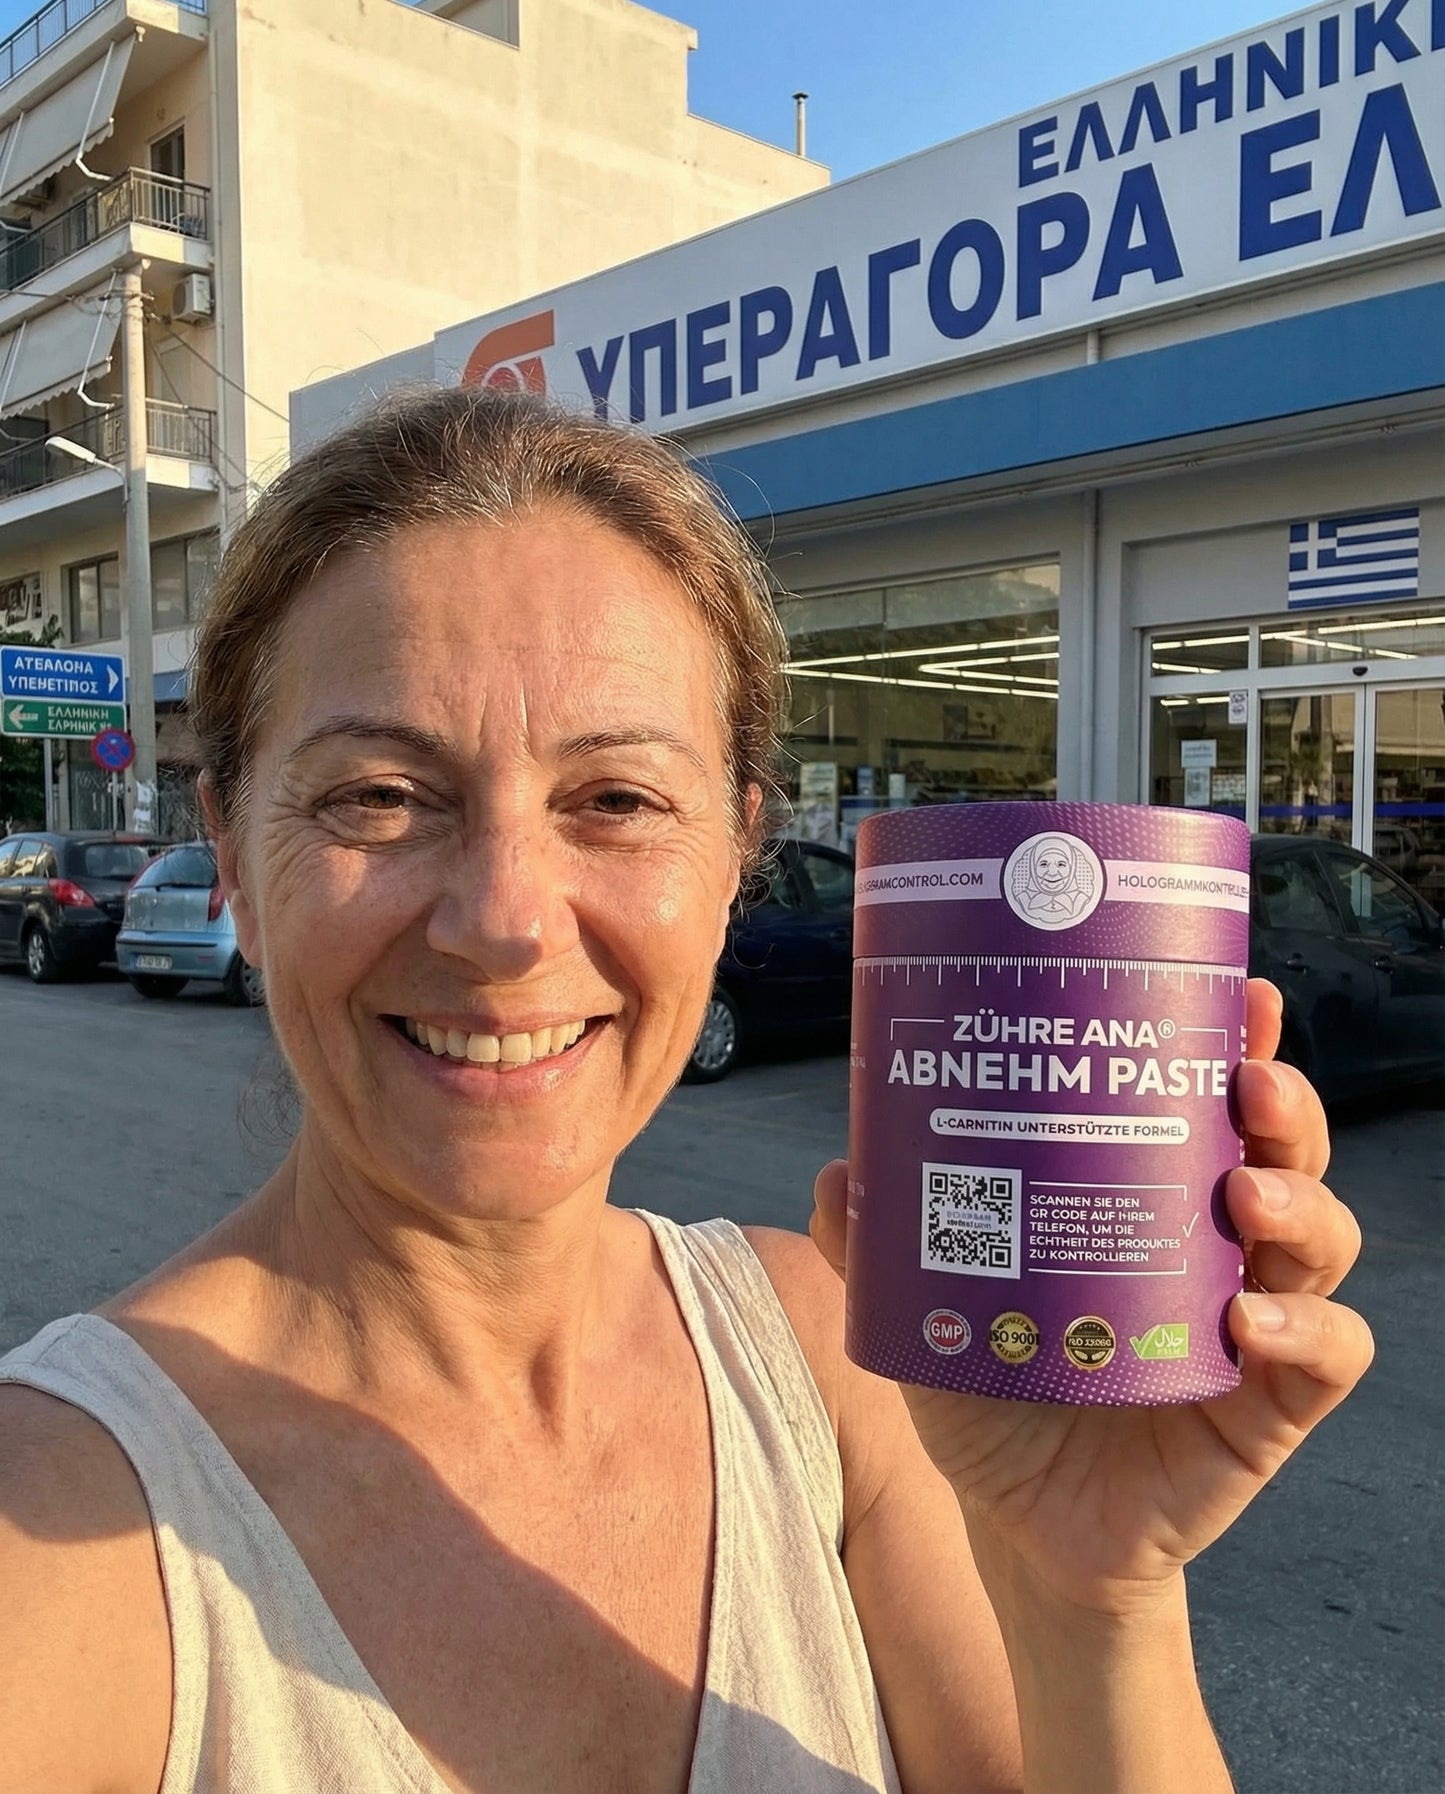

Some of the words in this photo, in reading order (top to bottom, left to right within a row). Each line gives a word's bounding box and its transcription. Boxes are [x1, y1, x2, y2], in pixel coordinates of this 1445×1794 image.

[576, 162, 1185, 424] ΥΠΕΡΑΓΟΡΑ
[1239, 82, 1442, 262] ΕΛ
[953, 1008, 1075, 1045] ZÜHRE
[887, 1049, 1091, 1094] ABNEHM
[1108, 1057, 1228, 1097] PASTE
[937, 1117, 1013, 1133] L-CARNITIN
[1017, 1121, 1130, 1136] UNTERSTÜTZTE
[1134, 1125, 1184, 1137] FORMEL
[1030, 1194, 1091, 1207] SCANNEN
[1093, 1197, 1113, 1208] SIE
[1115, 1198, 1140, 1208] DEN
[1051, 1209, 1087, 1220] CODE
[1090, 1211, 1116, 1221] AUF
[1030, 1221, 1090, 1235] TELEFON,
[1092, 1224, 1112, 1235] UM
[1115, 1225, 1135, 1235] DIE
[1029, 1235, 1089, 1247] ECHTHEIT
[1091, 1238, 1115, 1248] DES
[1029, 1248, 1046, 1259] ZU
[1049, 1250, 1149, 1262] KONTROLLIEREN
[931, 1321, 963, 1340] GMP
[990, 1330, 1009, 1343] ISO
